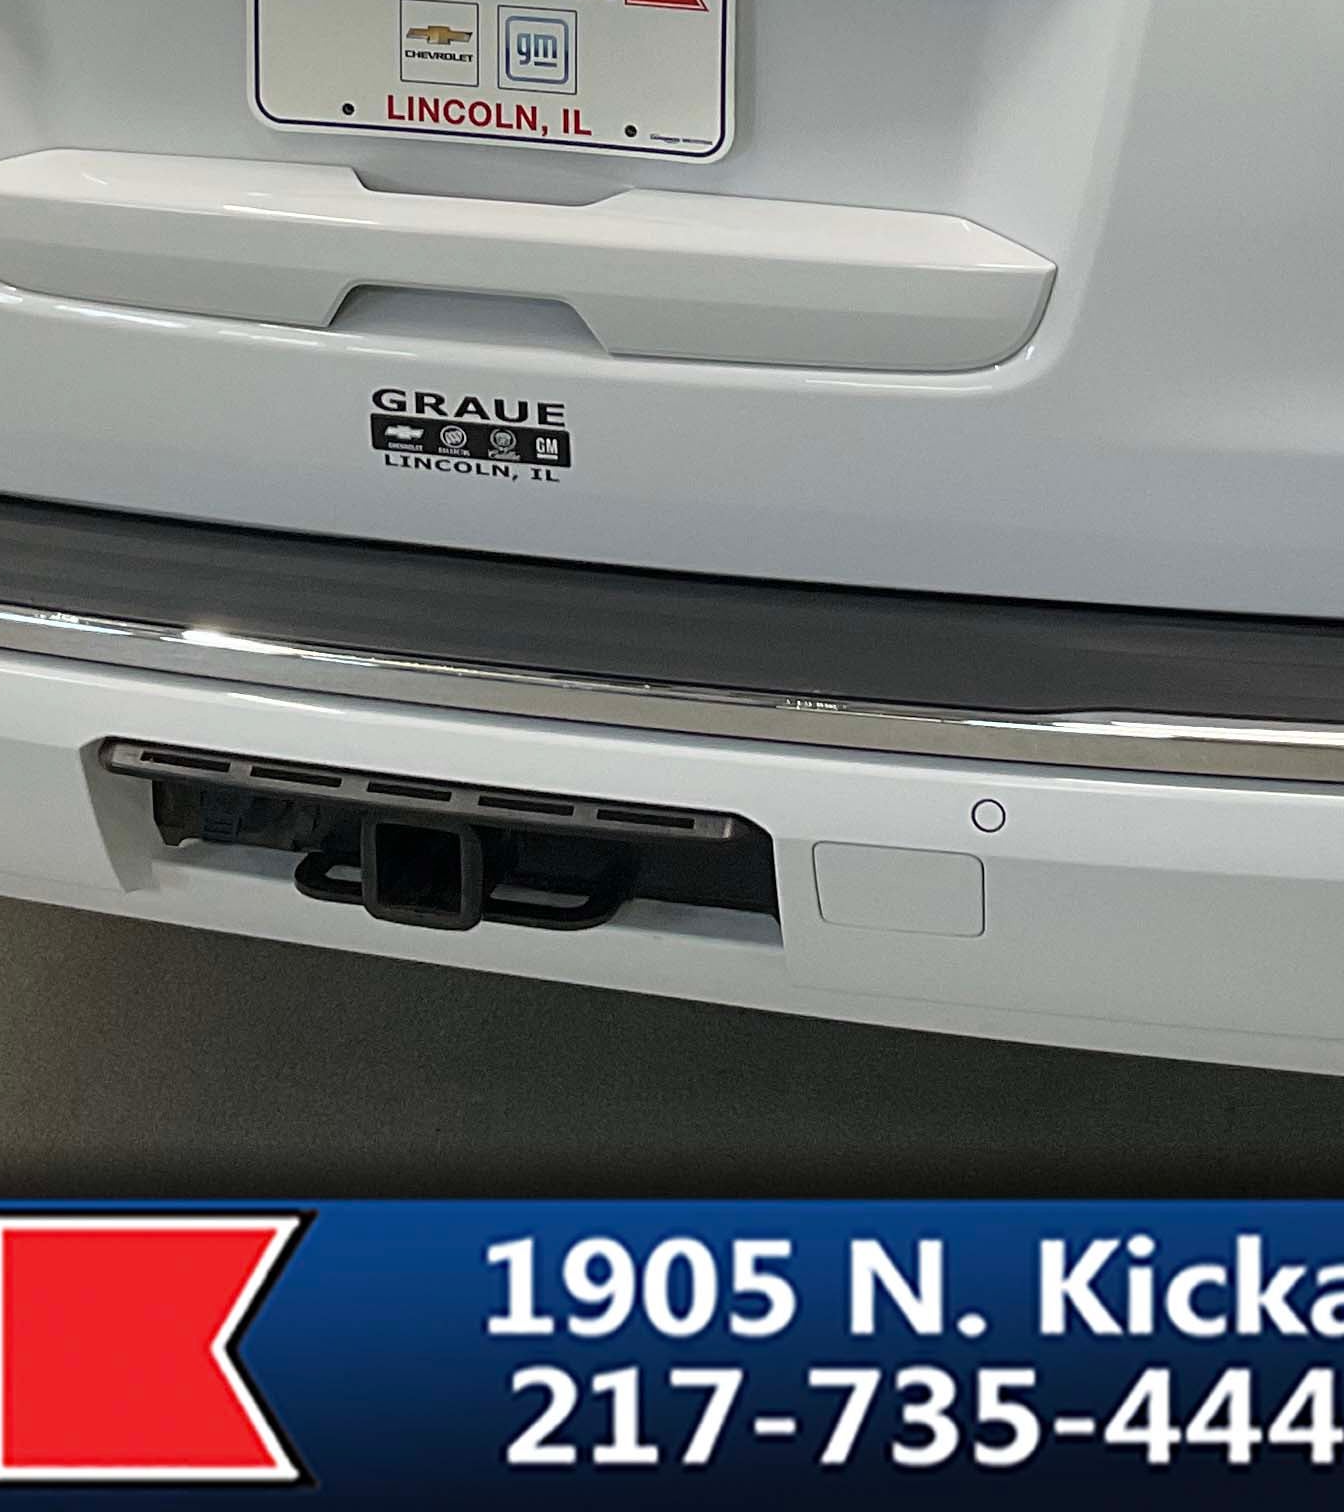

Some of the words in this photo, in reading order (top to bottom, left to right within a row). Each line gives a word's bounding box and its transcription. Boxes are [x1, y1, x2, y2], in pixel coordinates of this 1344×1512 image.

[404, 50, 473, 63] CHEVROLET
[517, 32, 558, 67] gm
[387, 95, 549, 136] LINCOLN,
[562, 109, 592, 136] IL
[372, 388, 566, 428] GRAUE
[385, 454, 519, 481] LINCOLN,
[531, 467, 561, 483] IL
